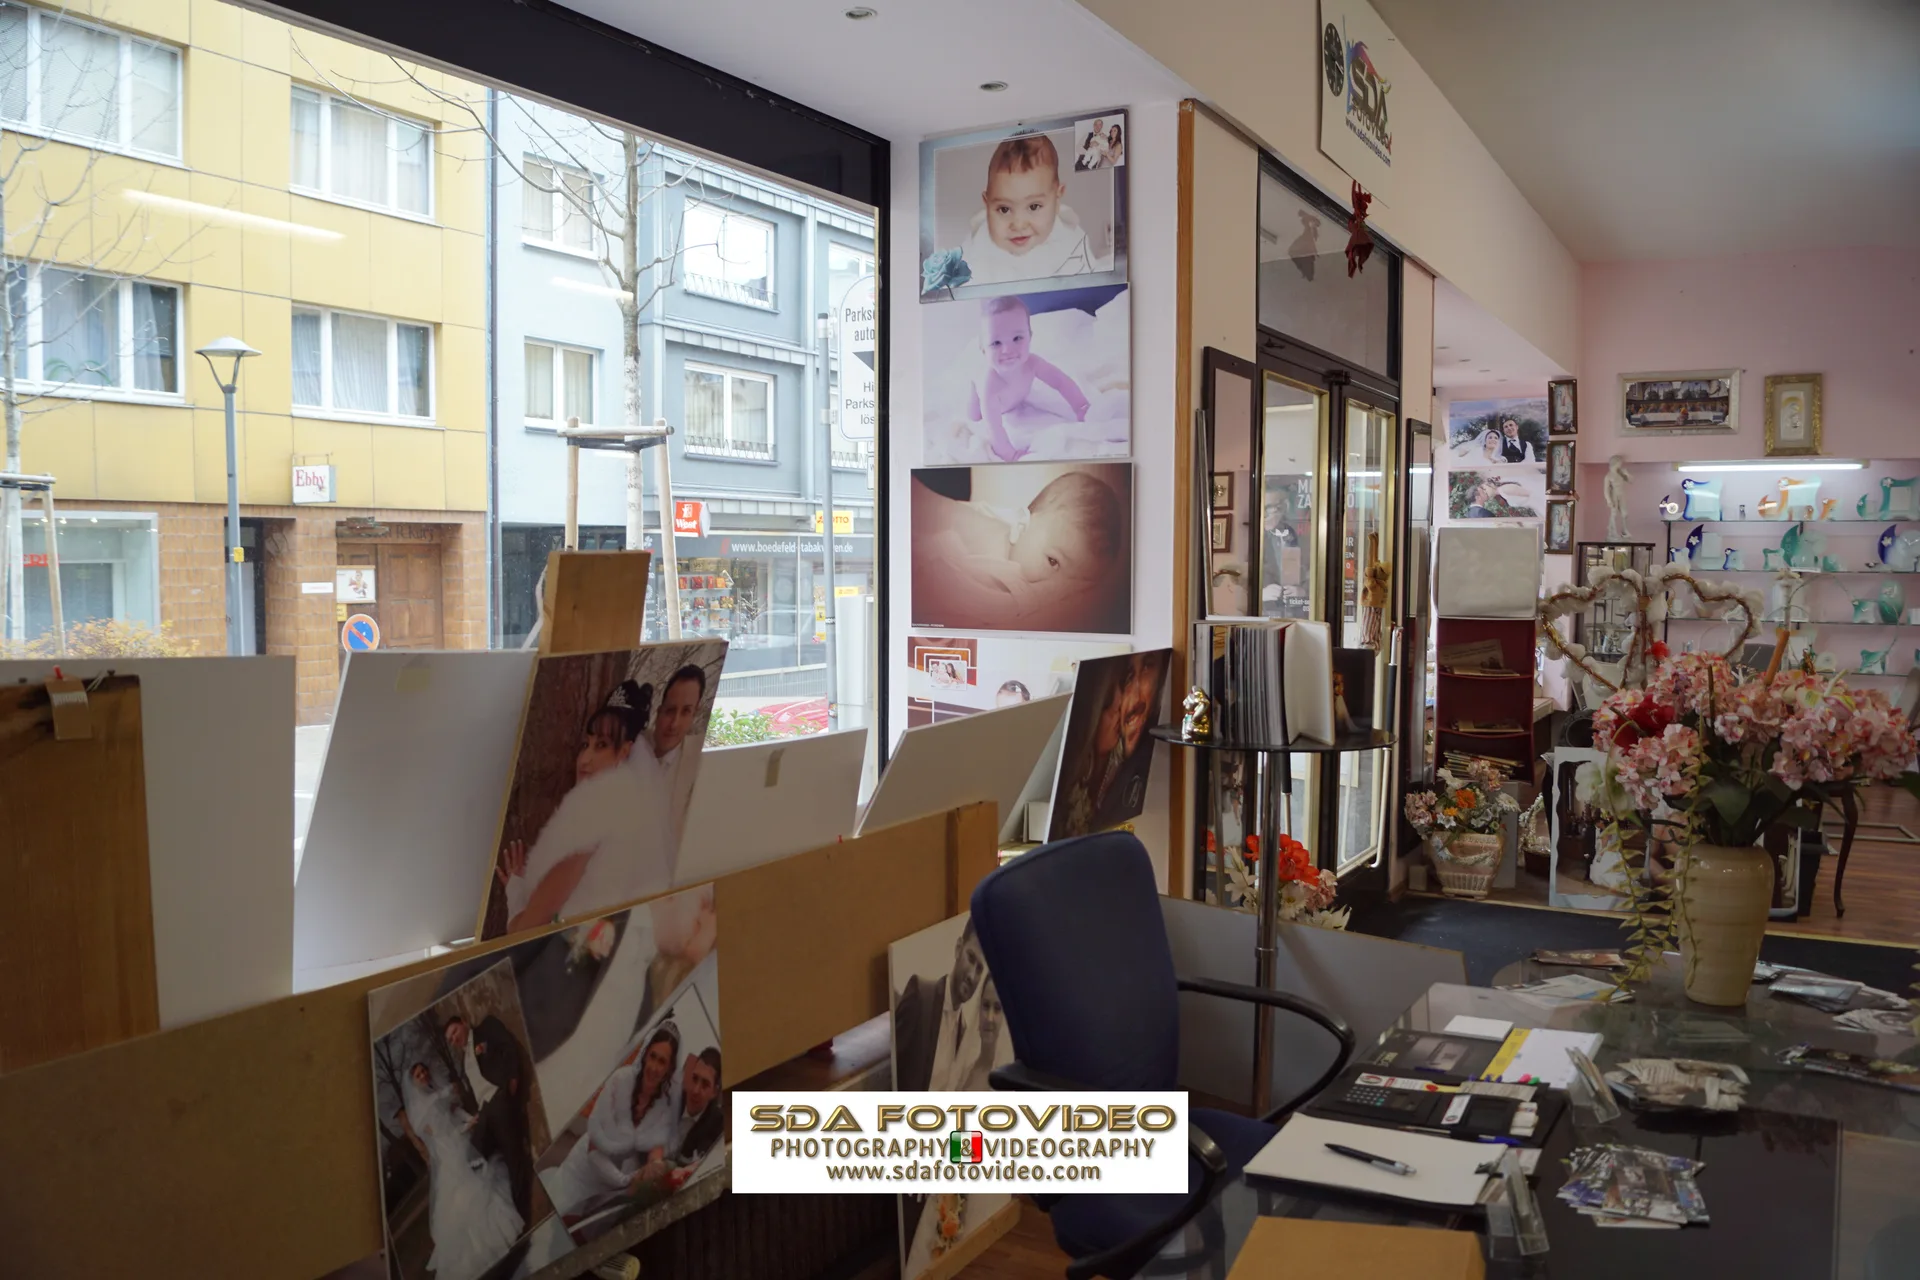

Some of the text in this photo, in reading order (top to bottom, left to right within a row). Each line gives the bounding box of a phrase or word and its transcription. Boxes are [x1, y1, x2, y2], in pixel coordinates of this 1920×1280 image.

[854, 327, 875, 341] auto
[863, 381, 874, 392] Hi
[845, 398, 875, 409] Parks
[860, 413, 875, 424] lös
[295, 469, 325, 488] Ebby
